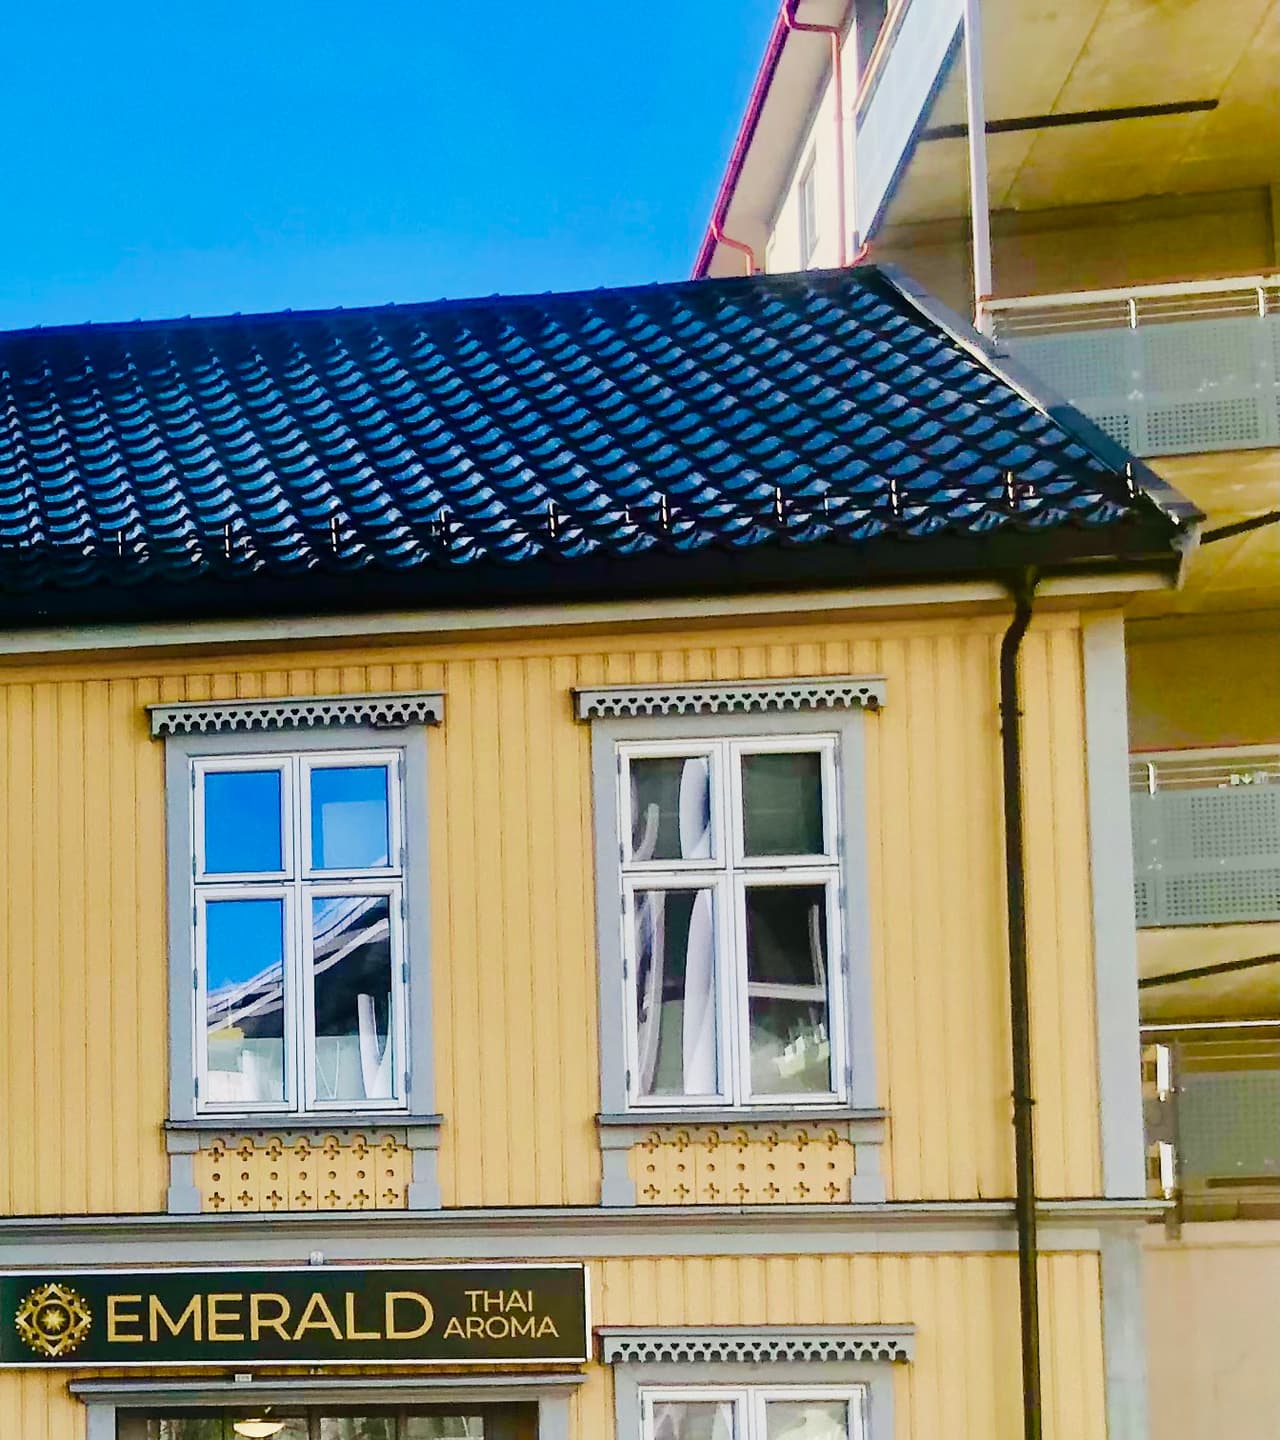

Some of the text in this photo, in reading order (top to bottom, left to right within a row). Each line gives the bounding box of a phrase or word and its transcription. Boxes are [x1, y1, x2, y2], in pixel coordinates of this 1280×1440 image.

[464, 1289, 534, 1313] THAI
[106, 1290, 434, 1342] EMERALD
[443, 1315, 560, 1340] AROMA
